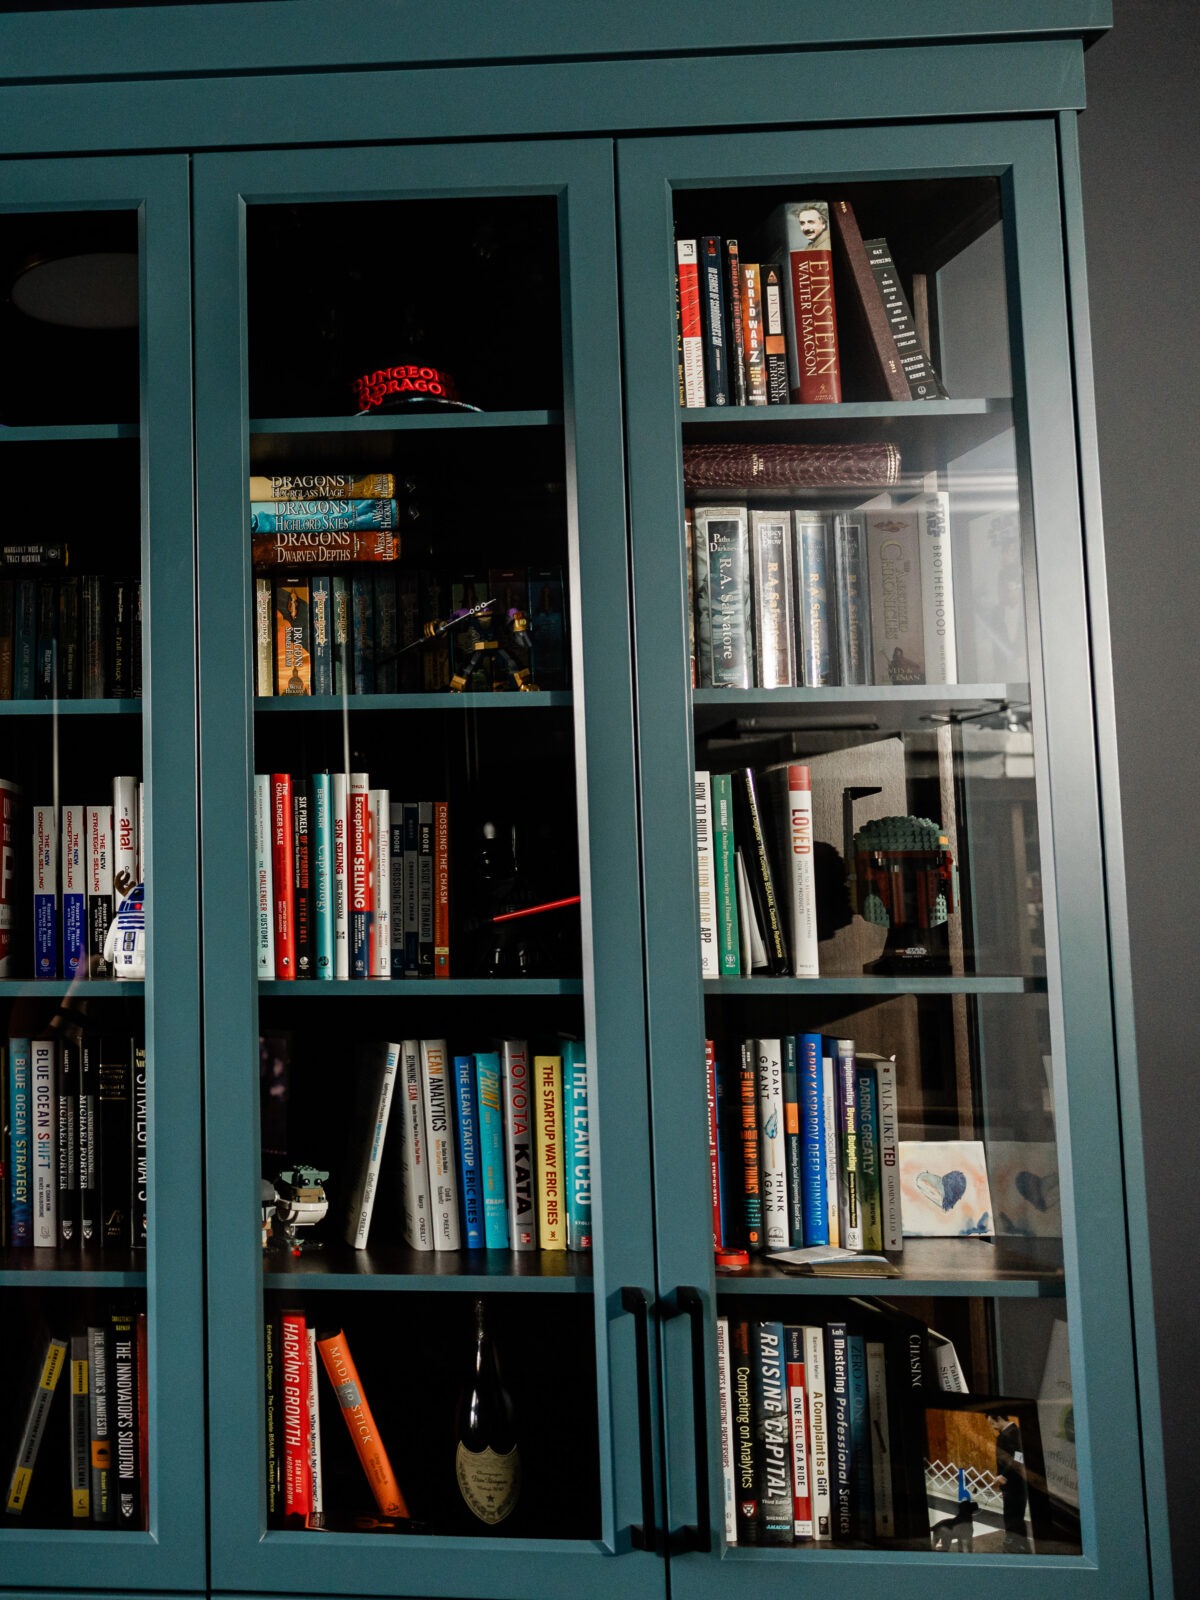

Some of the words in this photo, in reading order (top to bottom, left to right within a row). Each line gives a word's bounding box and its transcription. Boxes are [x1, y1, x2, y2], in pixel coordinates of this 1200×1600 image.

[799, 261, 811, 309] WALTER
[810, 261, 837, 375] EINSTEIN
[802, 315, 817, 376] ISAACSON
[768, 356, 778, 403] HERBERT
[777, 361, 786, 397] FRANK
[272, 475, 344, 488] DRAGONS
[275, 501, 349, 515] DRAGONS
[277, 532, 350, 546] DRAGONS
[277, 547, 317, 562] DWARVEN
[319, 546, 350, 561] DEPTHS
[720, 558, 733, 590] R.A.
[933, 546, 945, 635] BROTHERHOOD
[721, 595, 735, 659] Salvatore
[276, 782, 284, 827] CHALLENGER
[695, 783, 705, 800] HOW
[696, 805, 706, 814] TO
[335, 819, 343, 839] SPIN
[355, 796, 365, 854] Exceptional
[439, 806, 447, 851] CROSSING
[792, 809, 810, 854] LOVED
[335, 842, 344, 875] SELLING
[440, 853, 448, 870] THE
[354, 857, 365, 909] SELLING
[440, 872, 448, 904] CHASM
[701, 928, 711, 942] APP
[15, 1058, 26, 1089] BLUE
[37, 1049, 49, 1081] BLUE
[406, 1055, 417, 1084] RUNNING
[427, 1049, 443, 1074] LEAN
[543, 1065, 554, 1086] THE
[760, 1057, 768, 1099] GRANT
[37, 1086, 50, 1128] OCEAN
[408, 1085, 418, 1101] LEAN
[429, 1077, 447, 1132] ANALYTICS
[511, 1051, 528, 1136] TOYOTA
[859, 1078, 871, 1121] DARING
[882, 1080, 892, 1110] TALK
[16, 1093, 26, 1135] OCEAN
[59, 1095, 68, 1146] MICHAEL
[79, 1095, 88, 1146] MICHAEL
[543, 1090, 556, 1140] STARTUP
[883, 1116, 894, 1142] LIKE
[38, 1132, 50, 1170] SHIFT
[545, 1143, 556, 1169] WAY
[862, 1124, 873, 1175] GREATLY
[884, 1146, 895, 1166] TED
[16, 1139, 27, 1203] STRATEGY
[59, 1148, 67, 1190] PORTER
[514, 1143, 532, 1215] KATA
[546, 1171, 557, 1197] ERIC
[764, 1172, 772, 1211] AGAIN
[547, 1200, 558, 1225] RIES
[94, 1332, 105, 1345] THE
[284, 1323, 304, 1383] HACKING
[95, 1347, 106, 1393] INNOVATOR'S
[760, 1333, 781, 1411] RAISING
[329, 1346, 351, 1385] MADE
[344, 1389, 354, 1401] to
[351, 1404, 372, 1444] STICK
[736, 1367, 750, 1422] Competing
[794, 1398, 802, 1414] ONE
[96, 1395, 107, 1436] MANIFESTO
[284, 1386, 301, 1446] GROWTH
[310, 1414, 318, 1431] Who
[740, 1426, 750, 1437] on
[795, 1418, 804, 1439] HELL
[813, 1402, 826, 1455] Complaint
[309, 1459, 318, 1469] My
[740, 1442, 753, 1488] Analytics
[764, 1420, 786, 1498] CAPITAL
[796, 1443, 804, 1453] OF
[817, 1458, 826, 1466] Is
[310, 1471, 318, 1502] Cheese?
[797, 1466, 805, 1485] RIDE
[817, 1478, 827, 1495] Gift
